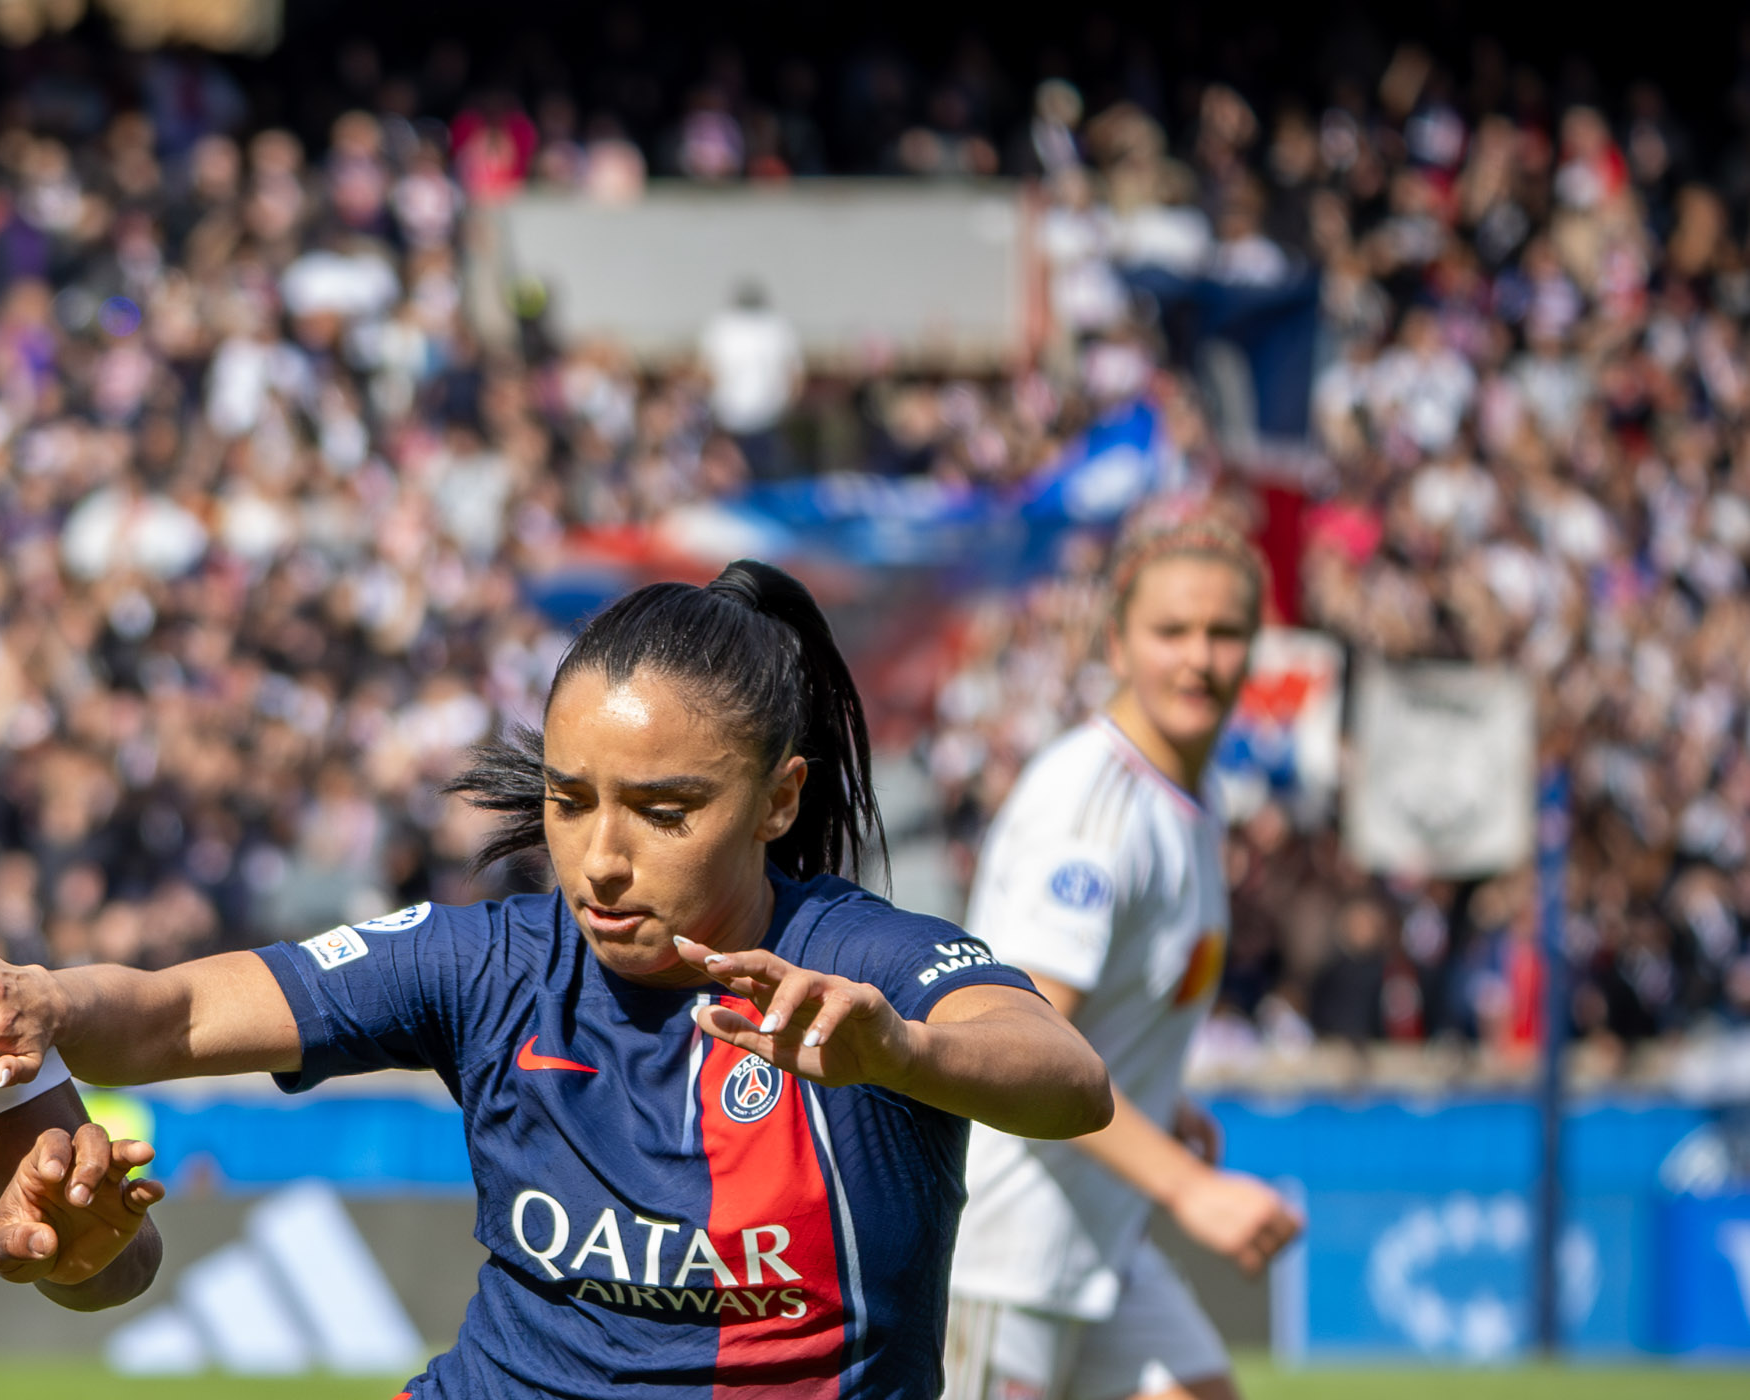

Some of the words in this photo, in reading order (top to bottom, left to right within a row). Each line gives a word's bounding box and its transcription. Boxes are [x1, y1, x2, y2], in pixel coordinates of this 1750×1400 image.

[918, 955, 998, 987] RWA
[511, 1188, 803, 1287] QATAR
[575, 1278, 808, 1320] AIRWAYS
